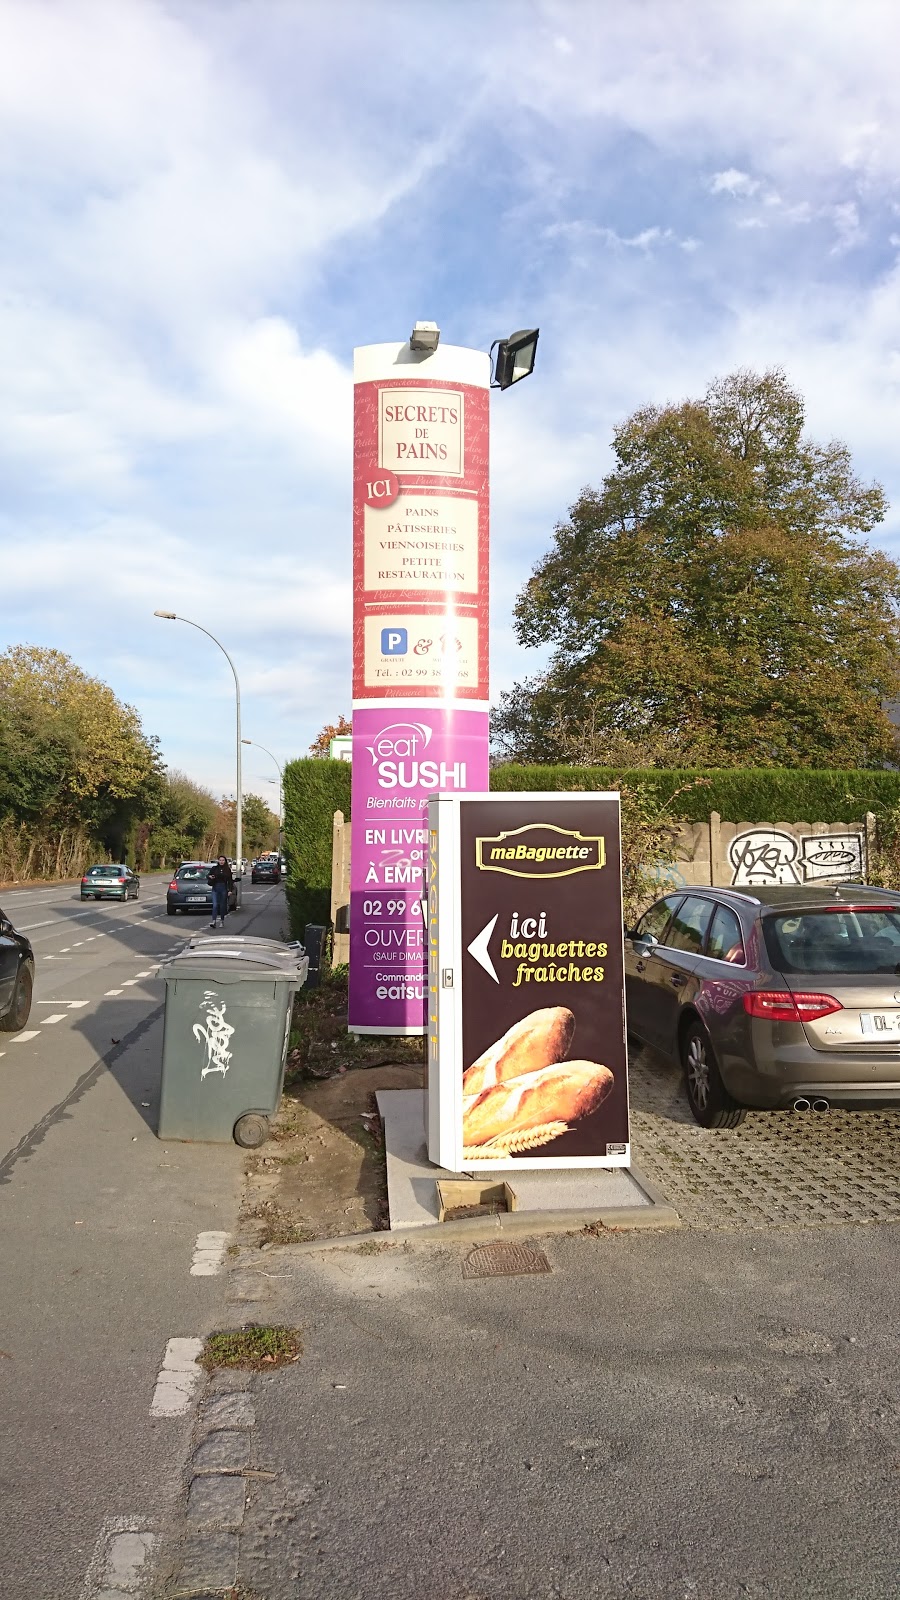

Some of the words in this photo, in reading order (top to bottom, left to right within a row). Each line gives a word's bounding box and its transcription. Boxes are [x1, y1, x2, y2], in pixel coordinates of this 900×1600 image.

[385, 405, 458, 424] SECRETS
[415, 428, 429, 439] DE
[396, 442, 448, 460] PAINS
[366, 479, 392, 499] ICI
[405, 508, 439, 517] PAINS
[387, 522, 457, 534] PÂTISSERIES
[379, 541, 465, 552] VIENNOISERIES
[402, 557, 442, 566] PETITE
[378, 570, 465, 581] RESTAURATION
[401, 668, 413, 677] 02
[416, 668, 428, 677] 99
[377, 734, 419, 757] eat
[377, 760, 467, 789] SUSHI
[366, 796, 416, 809] Bienfaits
[365, 828, 386, 845] EN
[490, 845, 592, 862] maBaguette
[365, 861, 379, 884] À
[384, 866, 424, 884] EMP
[363, 900, 382, 916] 02
[387, 900, 407, 916] 99
[510, 911, 548, 939] ici
[373, 951, 397, 961] (SAUF
[500, 939, 608, 962] baguettes
[512, 962, 605, 987] fraîches
